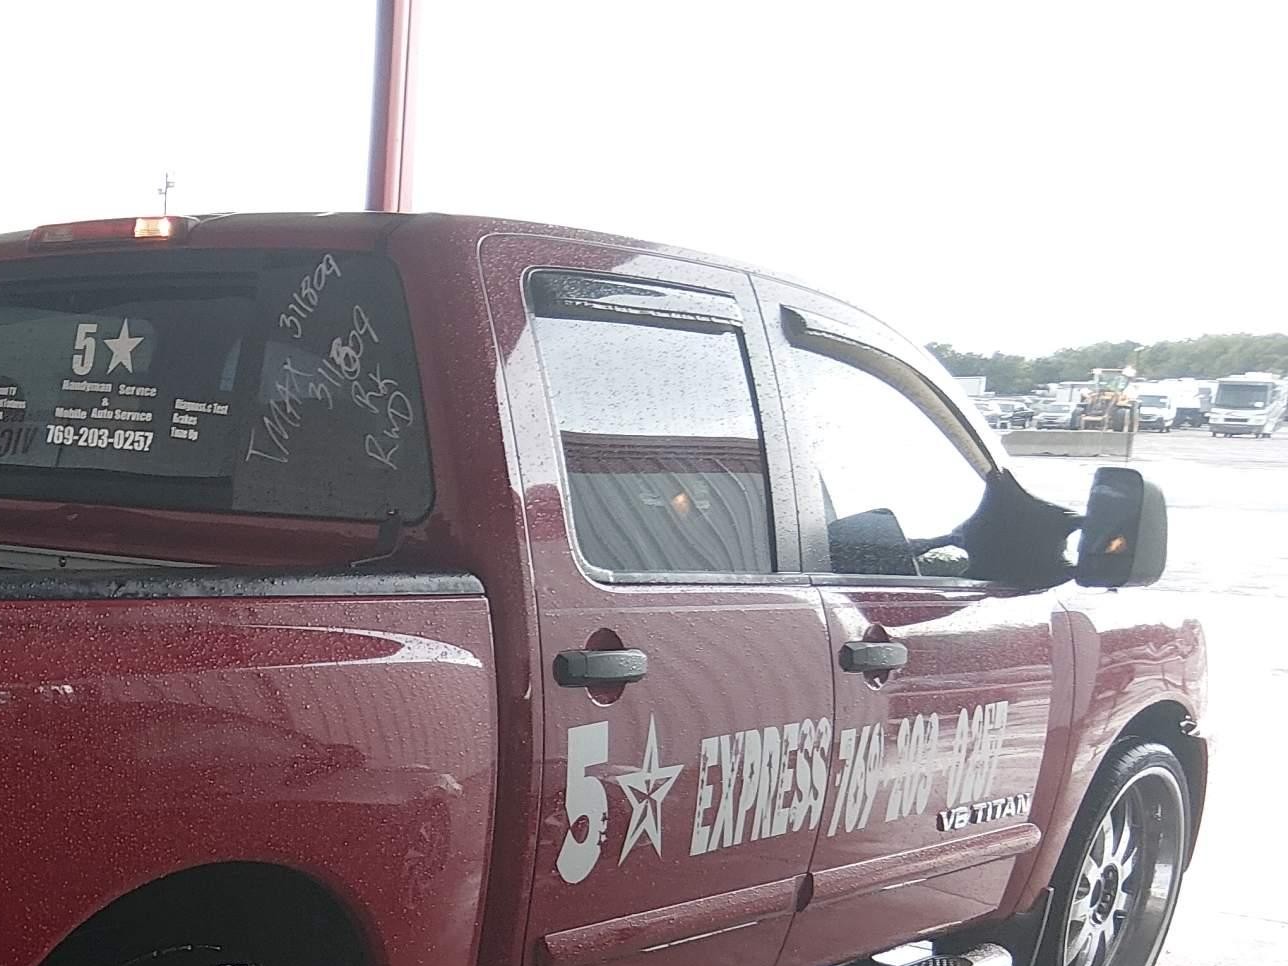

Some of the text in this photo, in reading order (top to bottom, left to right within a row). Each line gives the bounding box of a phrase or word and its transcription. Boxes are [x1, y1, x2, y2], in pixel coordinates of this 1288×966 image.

[279, 253, 342, 338] 311809
[71, 323, 99, 375] 5
[62, 379, 157, 396] Handyman Service
[101, 397, 109, 406] &
[55, 407, 153, 422] Mobile Auto Service
[46, 424, 154, 451] 769-203-0257
[555, 720, 610, 885] 5
[689, 717, 834, 857] EXPRESS
[971, 792, 1032, 824] TITAN
